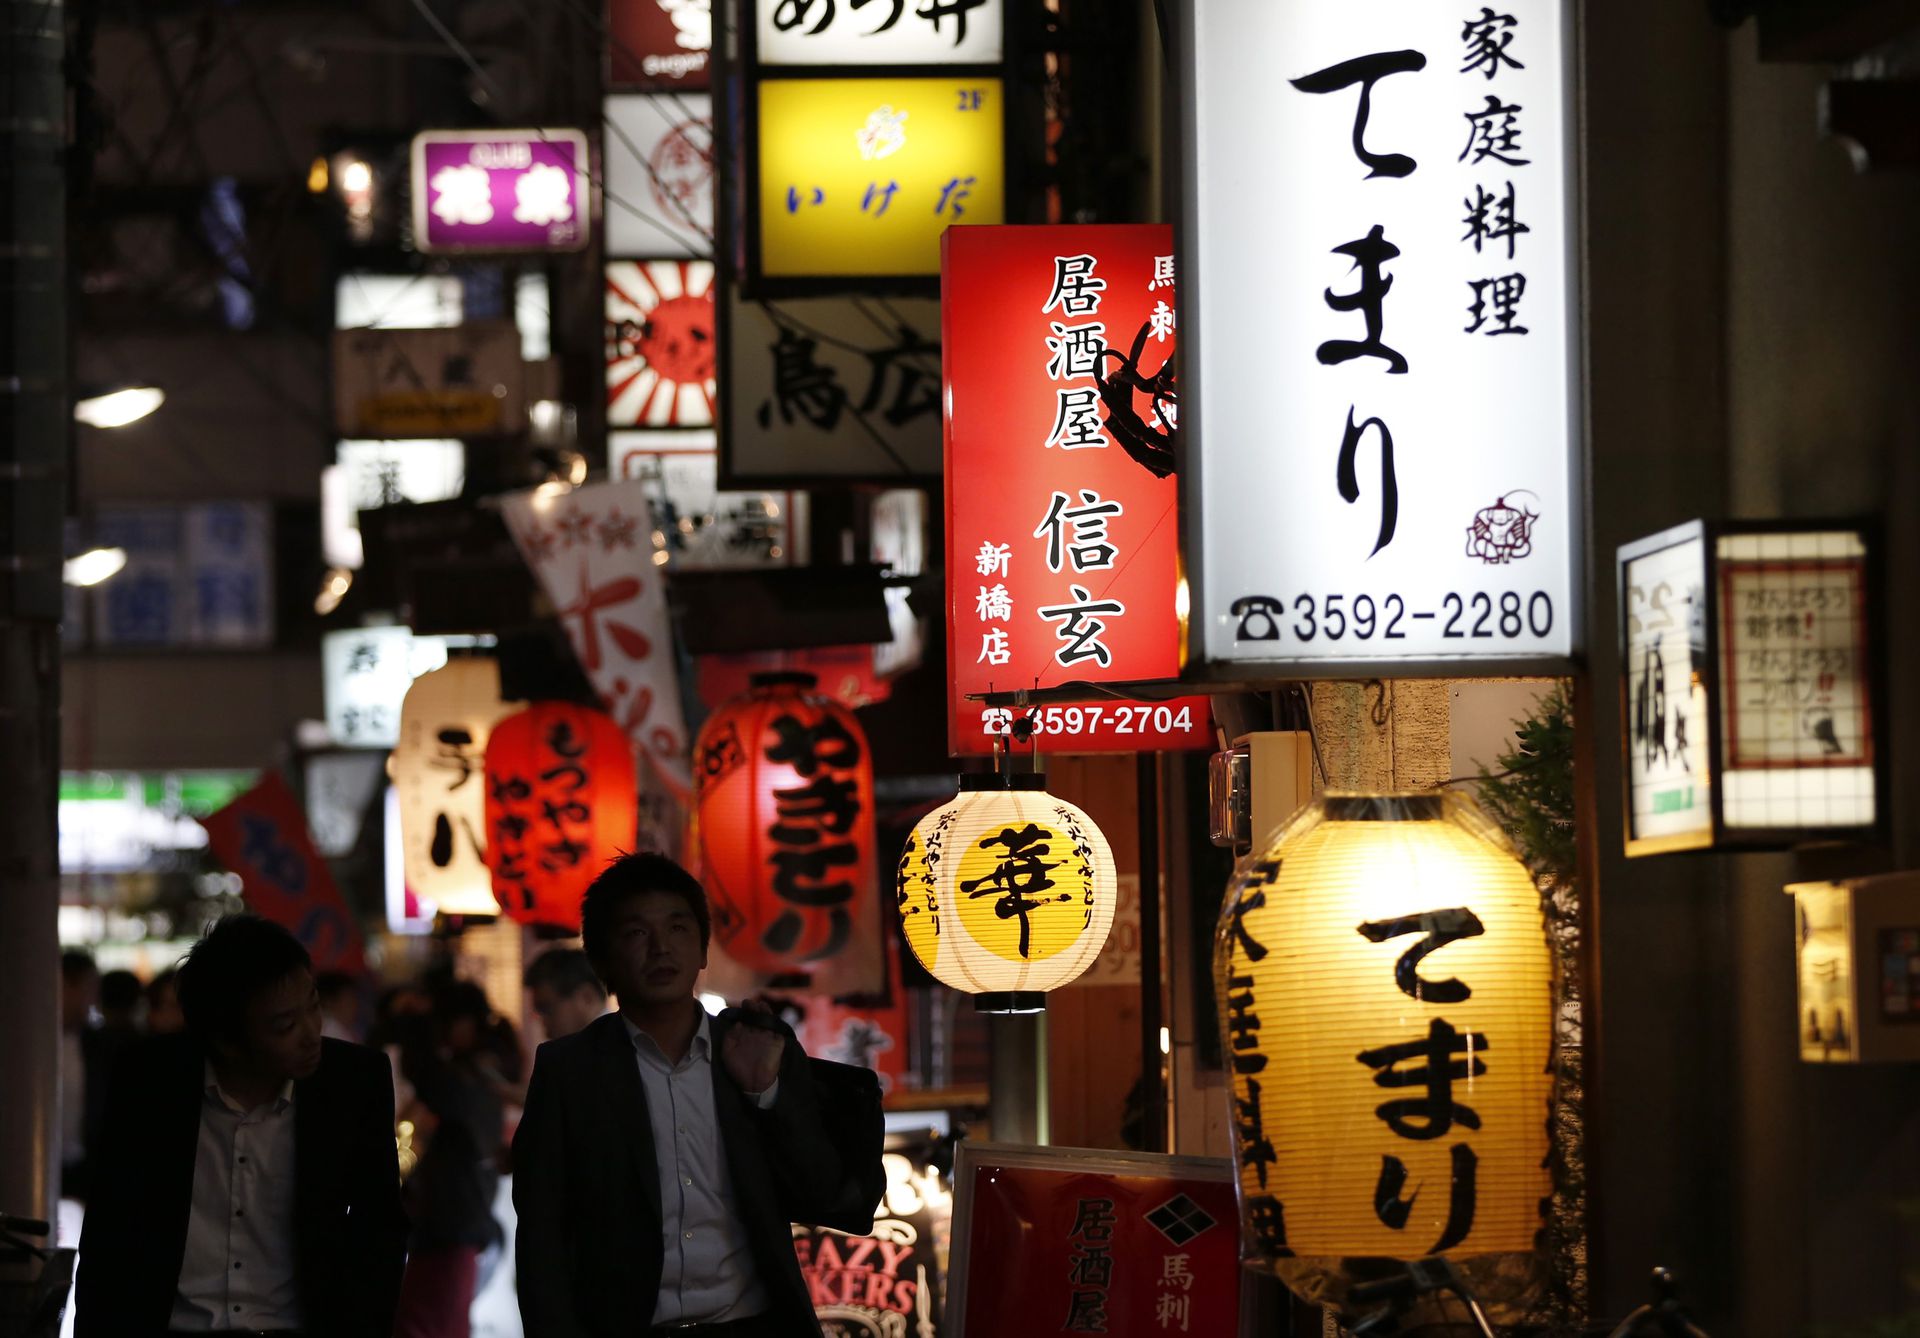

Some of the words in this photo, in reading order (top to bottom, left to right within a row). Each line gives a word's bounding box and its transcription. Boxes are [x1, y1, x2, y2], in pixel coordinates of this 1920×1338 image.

[787, 177, 976, 219] いけだ
[1459, 7, 1531, 336] 家庭料理
[1043, 254, 1108, 449] 居酒屋
[1287, 49, 1427, 560] てまり
[975, 540, 1014, 666] 新橋店
[1034, 489, 1124, 669] 信玄
[1293, 590, 1553, 640] 3592-2280
[763, 714, 861, 962] やきとり
[960, 823, 1072, 958] 華
[1357, 906, 1489, 1256] てまり
[1061, 1197, 1118, 1333] 居酒屋
[1156, 1253, 1194, 1332] 馬刺
